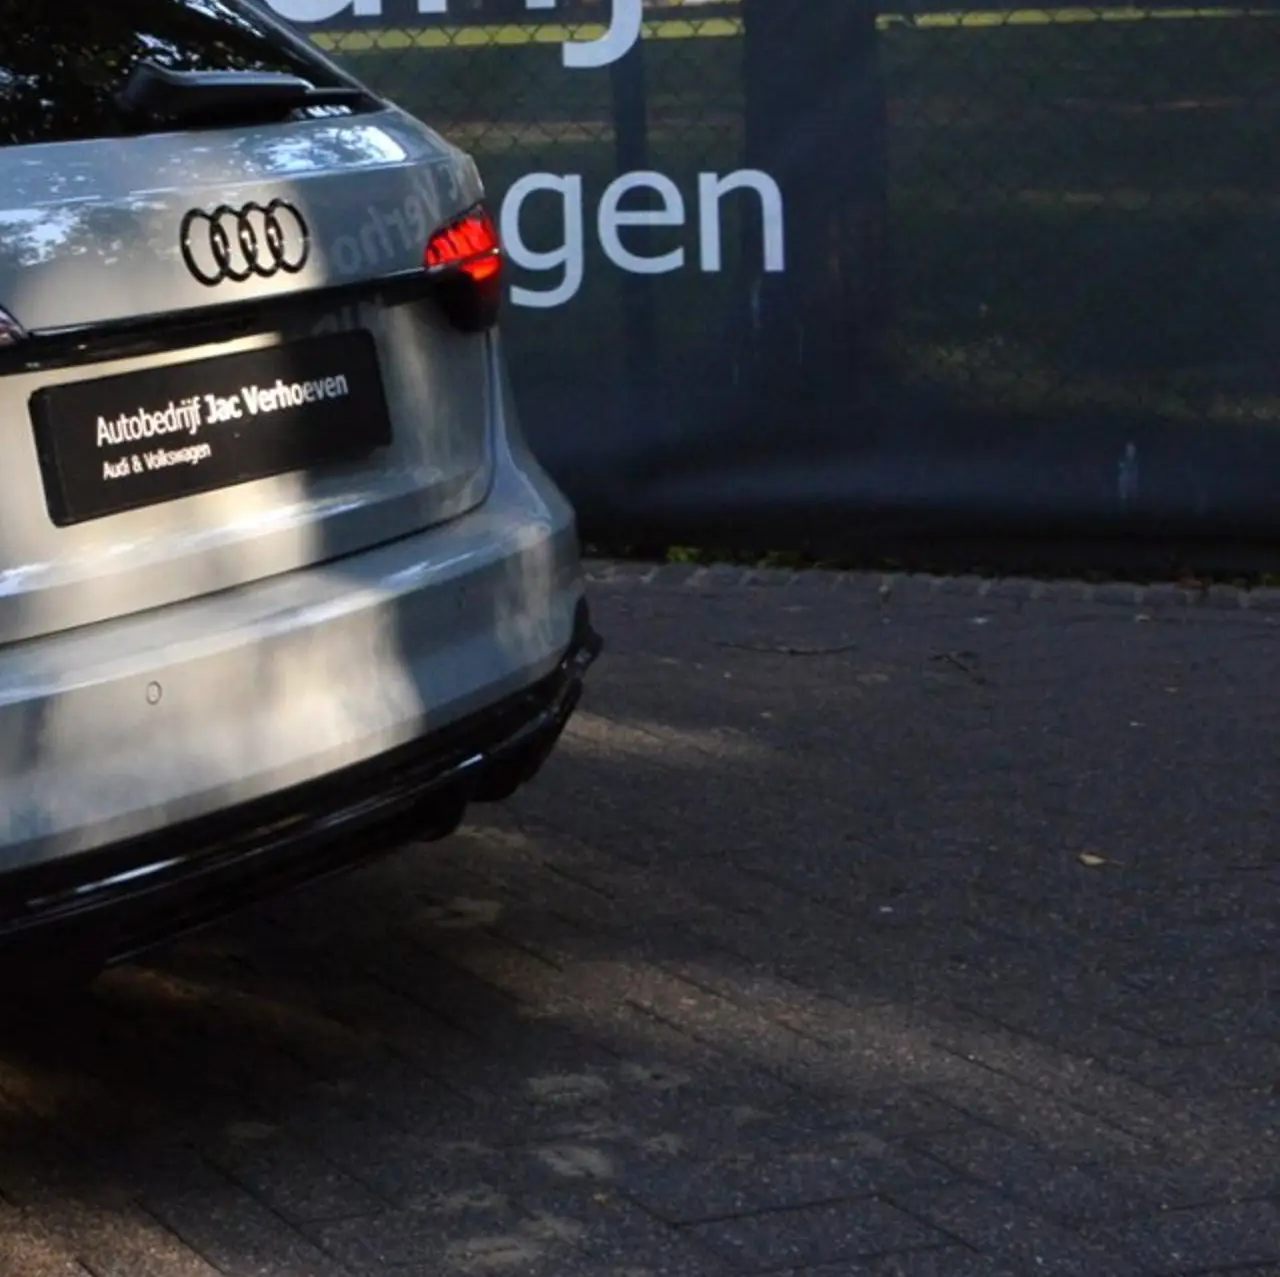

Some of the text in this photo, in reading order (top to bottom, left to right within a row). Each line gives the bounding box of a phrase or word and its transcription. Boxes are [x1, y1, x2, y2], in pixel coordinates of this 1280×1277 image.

[500, 169, 785, 308] gen
[96, 374, 349, 447] Autobedrijf Jac Verhoeven
[103, 443, 211, 480] Audi & Volkswagen
